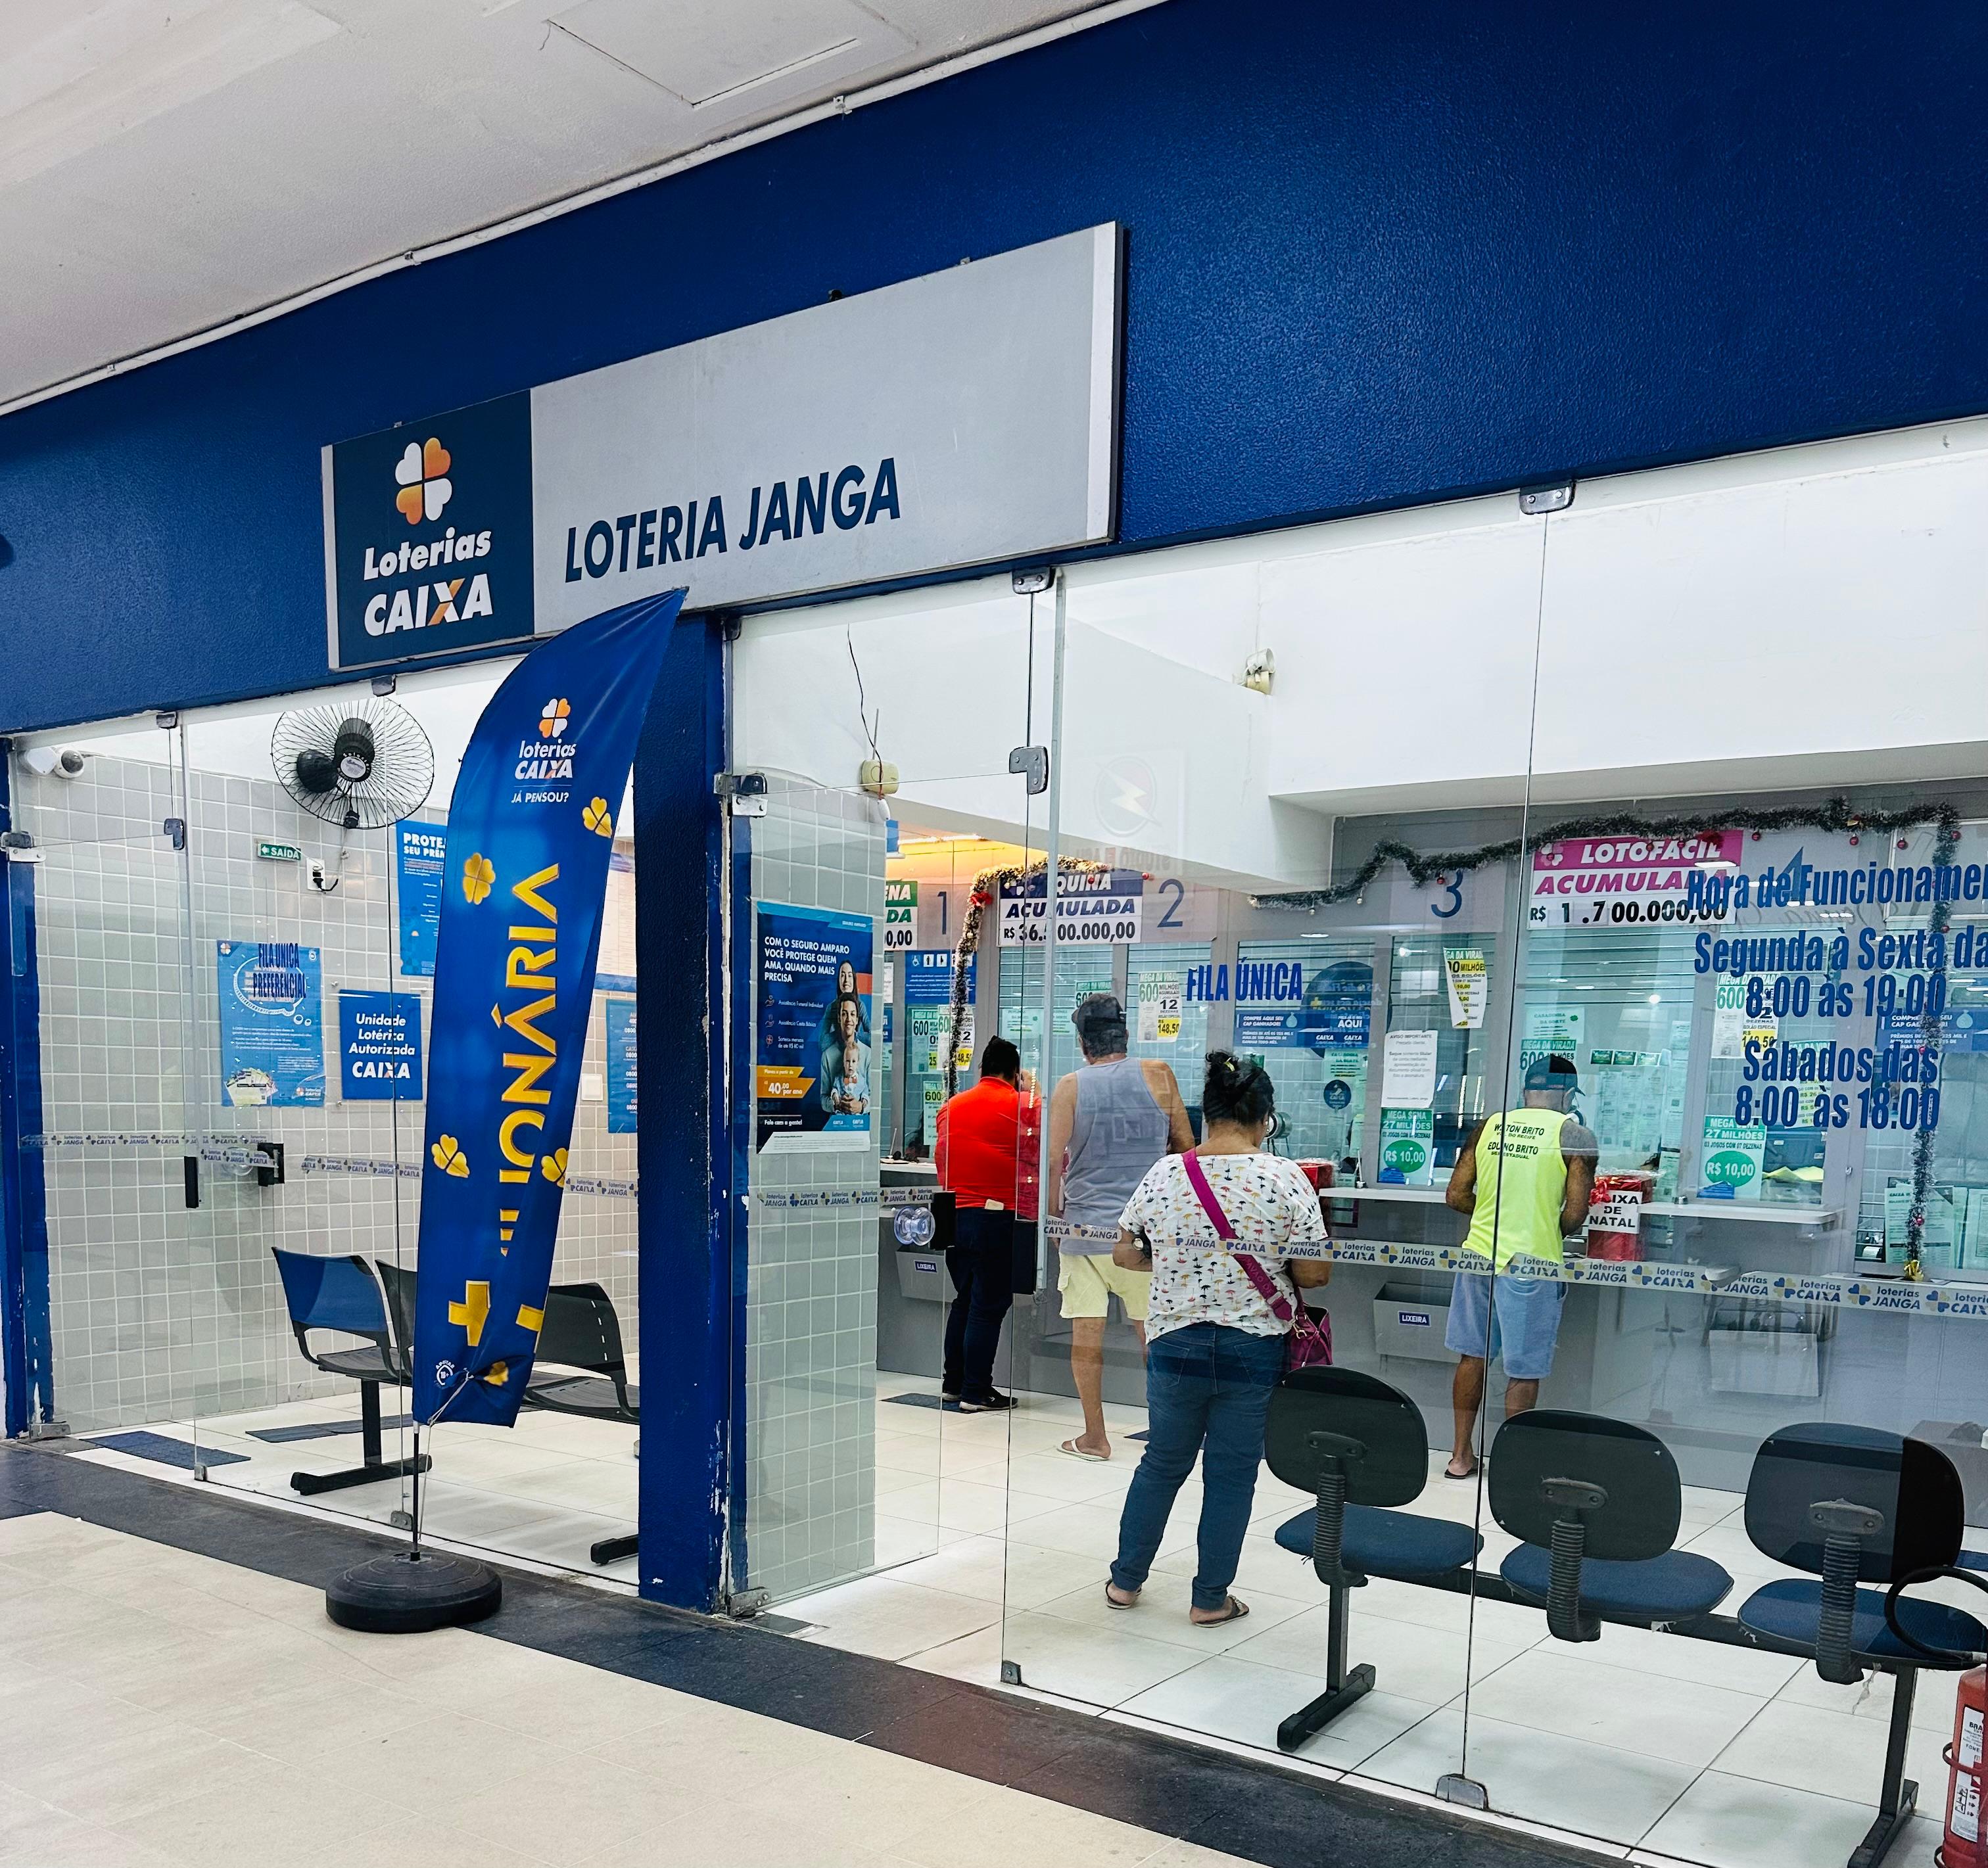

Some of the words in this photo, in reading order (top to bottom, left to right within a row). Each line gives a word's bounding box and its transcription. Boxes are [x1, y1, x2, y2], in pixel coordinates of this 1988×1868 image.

[565, 494, 728, 583] LOTERIA
[738, 457, 901, 551] JANGA
[363, 526, 492, 580] Loterias
[364, 572, 494, 637] CAIXA
[519, 738, 577, 759] loterias
[514, 759, 573, 780] CAIXA
[511, 789, 523, 803] JÁ
[525, 791, 570, 803] PENSOU?
[271, 846, 300, 860] SAÍDA
[404, 845, 421, 855] SEU
[1057, 873, 1112, 896] QUINA
[1688, 870, 1751, 911] Hora
[1757, 866, 1791, 908] de
[1431, 872, 1463, 918] 3
[1157, 878, 1184, 928] 2
[937, 891, 947, 935] 1
[1530, 906, 1546, 922] R$
[1004, 927, 1015, 940] R$
[1018, 922, 1135, 943] 36.00.000,00
[765, 936, 782, 946] COM
[783, 939, 790, 947] O
[791, 939, 819, 951] SEGURO
[820, 943, 850, 954] AMPARO
[1695, 929, 1824, 977] Segunda
[1830, 927, 1850, 971] à
[1858, 926, 1945, 970] Sexta
[258, 943, 274, 968] FILA
[765, 948, 784, 958] VOCÊ
[786, 950, 815, 962] PROTEGE
[816, 954, 837, 964] QUEM
[765, 960, 784, 971] AMA,
[785, 962, 816, 973] QUANDO
[818, 965, 835, 975] MAIS
[765, 972, 793, 983] PRECISA
[1187, 963, 1229, 1002] FILA
[1235, 956, 1303, 1002] ÚNICA
[253, 973, 306, 998] PREFERENCIAL
[1139, 983, 1158, 1002] 600
[1716, 987, 1745, 1009] 600
[1746, 975, 1811, 1018] 8:00
[1818, 974, 1854, 1018] às
[1864, 974, 1946, 1017] 19:00
[1160, 999, 1177, 1010] 12
[356, 1012, 406, 1027] Unidade
[1337, 1019, 1362, 1028] AQUI
[358, 1027, 405, 1041] Lotérica
[913, 1020, 929, 1036] 600
[349, 1042, 415, 1056] Autorizada
[1522, 1040, 1541, 1050] MEGA
[1542, 1040, 1551, 1050] DA
[1552, 1040, 1575, 1050] VIRADA
[1743, 1037, 1874, 1082] Sábados
[1882, 1040, 1939, 1083] das
[352, 1061, 410, 1079] CAIXA
[925, 1091, 941, 1101] 600
[1736, 1085, 1799, 1128] 8:00
[1813, 1085, 1850, 1129] às
[1858, 1087, 1941, 1130] 18:00
[1386, 1110, 1407, 1119] MEGA
[1710, 1118, 1734, 1127] MEGA
[1522, 1127, 1544, 1136] BRITO
[1705, 1129, 1721, 1138] 27
[1722, 1130, 1764, 1140] MILHÕES
[1516, 1144, 1538, 1155] BRITO
[1385, 1150, 1397, 1161] R$
[1400, 1151, 1425, 1165] 10,00
[1707, 1162, 1722, 1176] R$
[1725, 1163, 1754, 1179] 10,00
[575, 1184, 595, 1194] CAIXA
[607, 1188, 628, 1196] JANGA
[1604, 1205, 1622, 1215] DE
[1590, 1215, 1636, 1228] NATAL
[1044, 1225, 1070, 1236] CAIXA
[1089, 1230, 1118, 1240] JANGA
[1184, 1238, 1216, 1248] JANGA
[1235, 1242, 1266, 1253] CAIXA
[1344, 1242, 1375, 1252] loterias
[1287, 1248, 1321, 1257] JANGA
[1342, 1251, 1375, 1262] CAIXA
[1402, 1246, 1434, 1256] loterias
[1399, 1256, 1436, 1267] JANGA
[1457, 1260, 1495, 1271] CAIXA
[1523, 1256, 1559, 1267] loterias
[1590, 1262, 1626, 1273] loterias
[1521, 1265, 1559, 1278] CAIXA
[1586, 1271, 1628, 1283] JANGA
[1656, 1267, 1695, 1278] loterias
[1653, 1276, 1695, 1289] CAIXA
[1800, 1279, 1841, 1292] loterias
[1724, 1283, 1768, 1296] JANGA
[1796, 1289, 1841, 1303] CAIXA
[1877, 1286, 1920, 1298] loterias
[1872, 1296, 1921, 1311] JANGA
[1402, 1314, 1428, 1324] LIXEIRA
